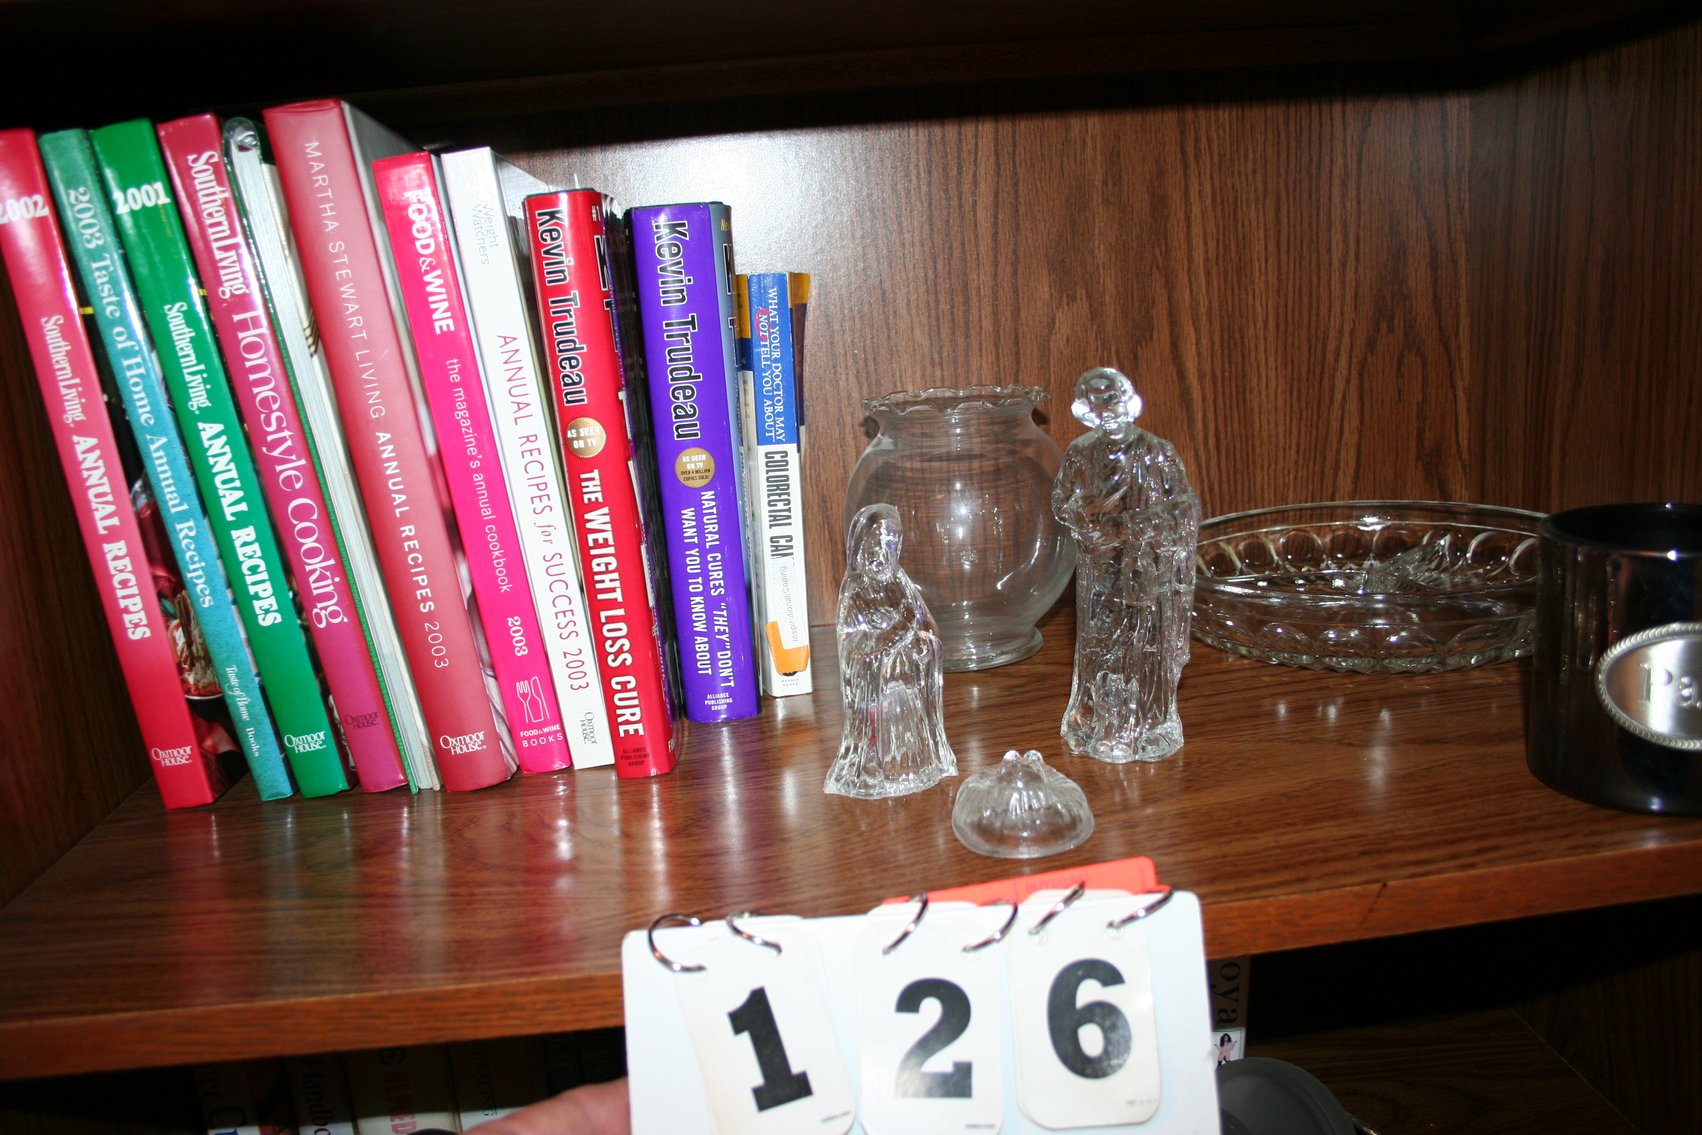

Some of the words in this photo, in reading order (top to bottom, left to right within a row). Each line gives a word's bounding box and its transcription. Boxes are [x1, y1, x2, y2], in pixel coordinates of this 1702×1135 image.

[68, 187, 105, 249] 2003
[113, 182, 171, 215] 2001
[472, 203, 490, 265] Watchers
[482, 204, 499, 248] Weight
[535, 208, 574, 286] Kevin
[653, 221, 693, 306] Kevin
[90, 253, 121, 320] Taste
[767, 287, 779, 324] WHAT
[112, 326, 139, 350] of
[548, 290, 588, 406] Trudeau
[758, 314, 769, 339] NOT
[770, 326, 780, 360] YOUR
[446, 358, 460, 383] the
[760, 339, 771, 369] TELL
[122, 357, 154, 427] Home
[497, 334, 533, 426] ANNUAL
[662, 314, 703, 441] Trudeau
[762, 370, 773, 396] YOU
[771, 363, 784, 414] DOCTOR
[304, 141, 338, 233] MARTHA
[329, 241, 367, 341] STEWART
[356, 350, 386, 419] LIVING
[375, 431, 411, 517] ANNUAL
[400, 525, 435, 613] RECIPES
[424, 621, 450, 669] 2003
[763, 399, 774, 437] ABOUT
[452, 387, 483, 468] magazine's
[567, 429, 577, 438] AS
[579, 426, 601, 437] SEEN
[573, 440, 585, 449] ON
[586, 438, 597, 447] TV
[774, 416, 786, 442] MAY
[146, 434, 190, 514] Annual
[232, 310, 306, 492] Homestyle
[288, 498, 348, 628] Cooking
[517, 434, 553, 515] RECIPES
[579, 469, 604, 504] THE
[764, 450, 792, 529] COLORECTAL
[472, 472, 497, 521] annual
[72, 435, 120, 535] ANNUAL
[103, 540, 151, 640] RECIPES
[197, 422, 247, 522] ANNUAL
[231, 525, 282, 627] RECIPES
[533, 523, 556, 544] for
[680, 507, 698, 544] WANT
[701, 490, 720, 549] NATURAL
[175, 518, 214, 609] Recipes
[485, 524, 513, 593] cookbook
[584, 506, 624, 602] WEIGHT
[685, 547, 701, 575] YOU
[707, 552, 725, 597] CURES
[543, 552, 579, 640] SUCCESS
[688, 577, 703, 593] TO
[507, 616, 528, 657] 2003
[690, 596, 708, 633] KNOW
[599, 608, 633, 668] LOSS
[694, 635, 712, 676] ABOUT
[562, 648, 589, 691] 2003
[717, 649, 735, 688] DON'T
[610, 674, 645, 739] CURE
[707, 692, 730, 700] ALLIANCE
[284, 731, 326, 748] Oxmoor
[440, 730, 486, 751] Oxmoor
[521, 733, 563, 748] BOOKS
[585, 711, 599, 744] Oxmoor
[151, 745, 192, 761] Oxmoor
[727, 985, 814, 1112] 1
[893, 977, 973, 1098] 2
[1046, 957, 1132, 1080] 6
